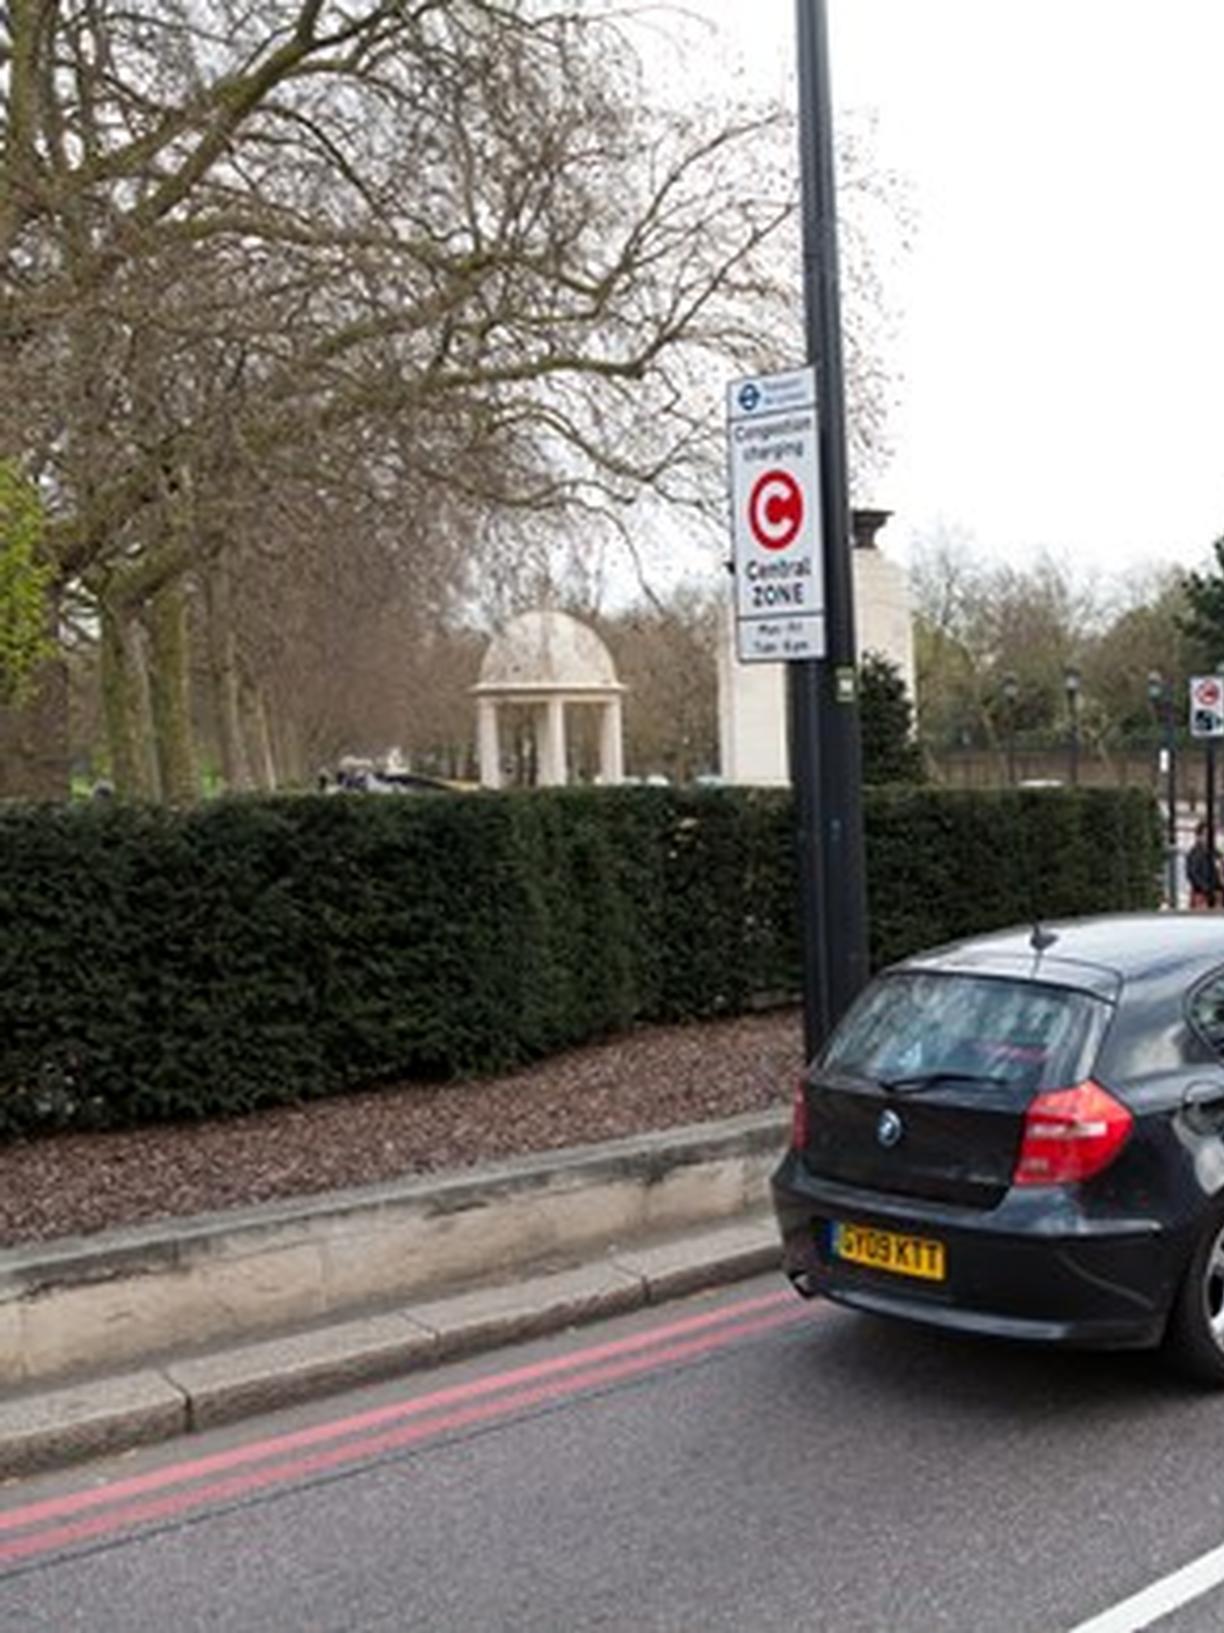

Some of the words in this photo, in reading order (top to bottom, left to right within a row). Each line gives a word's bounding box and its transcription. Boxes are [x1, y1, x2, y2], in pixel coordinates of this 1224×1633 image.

[746, 557, 811, 581] Central
[753, 583, 804, 608] ZONE
[896, 1238, 939, 1273] KTT
